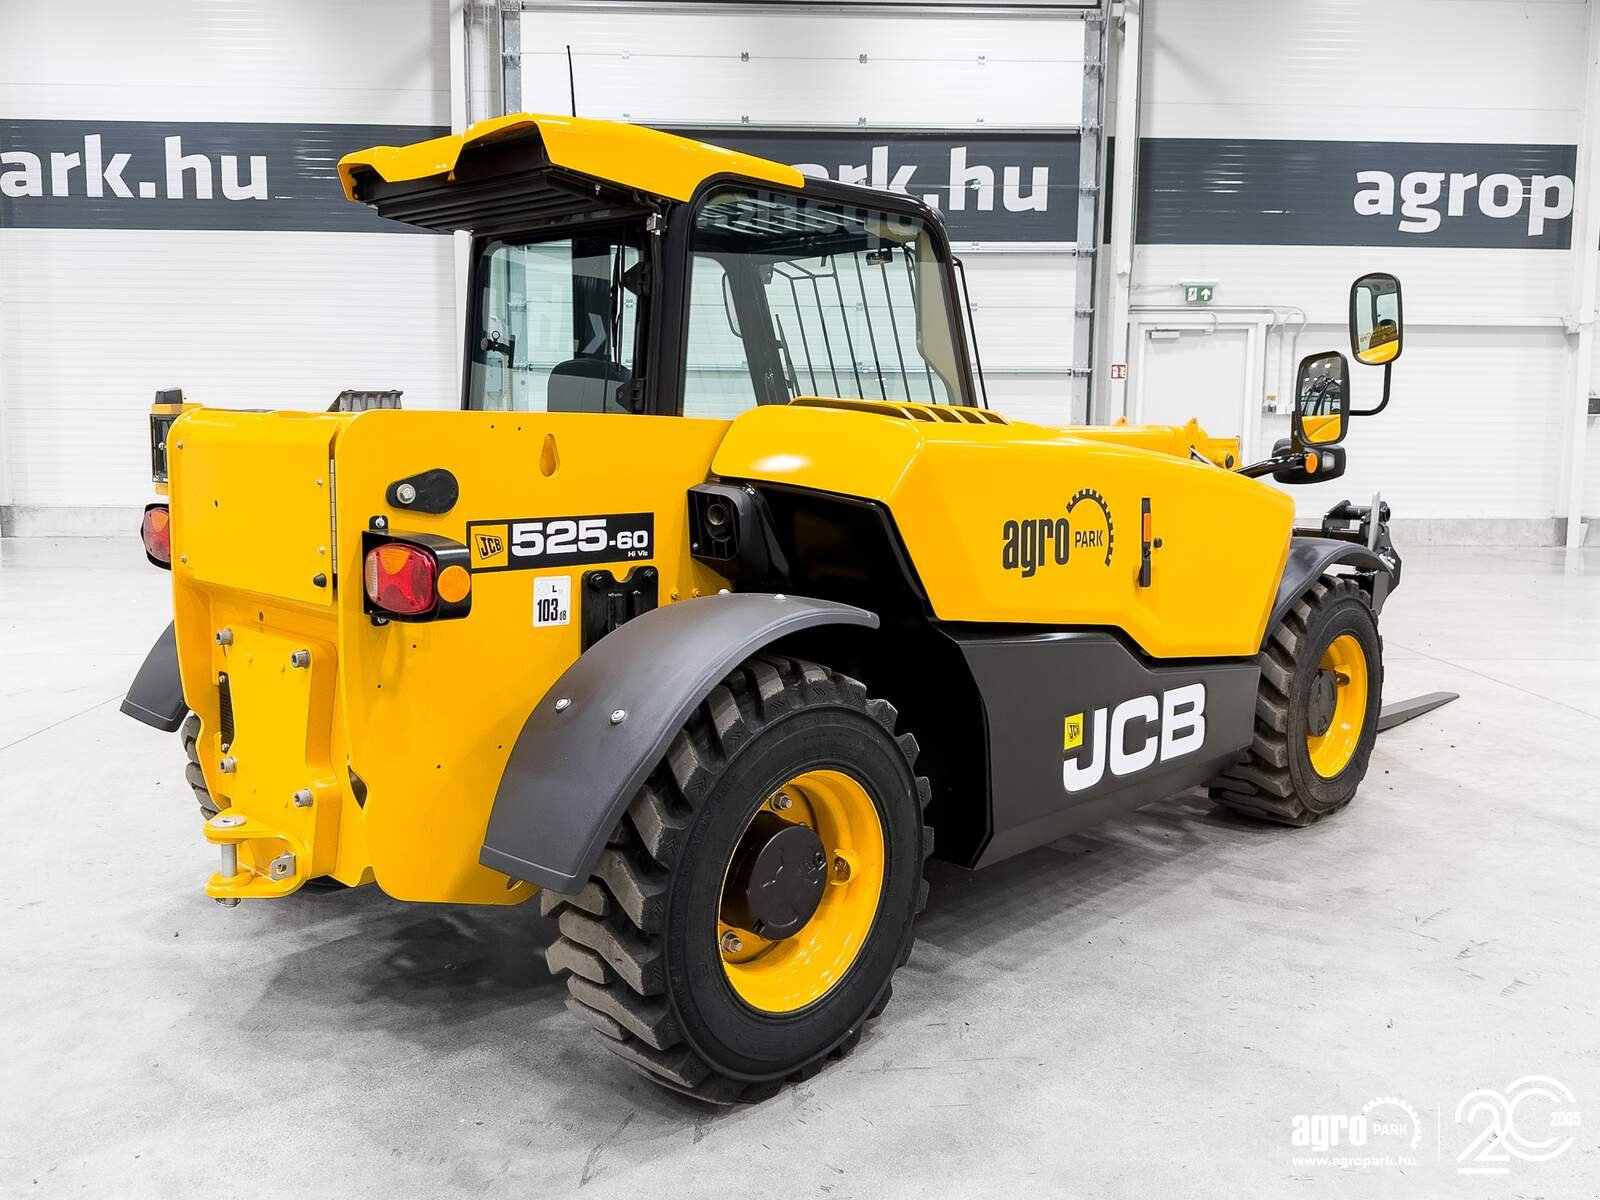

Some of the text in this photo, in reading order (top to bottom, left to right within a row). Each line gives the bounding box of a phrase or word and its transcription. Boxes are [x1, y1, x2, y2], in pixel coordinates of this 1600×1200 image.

[0, 134, 268, 200] ark.hu
[1353, 171, 1574, 236] agrop
[479, 536, 502, 557] JCB
[511, 519, 649, 557] 525-60
[1002, 518, 1103, 578] agro PARK
[537, 598, 558, 622] 103
[552, 584, 557, 593] L
[1063, 683, 1206, 792] JCB
